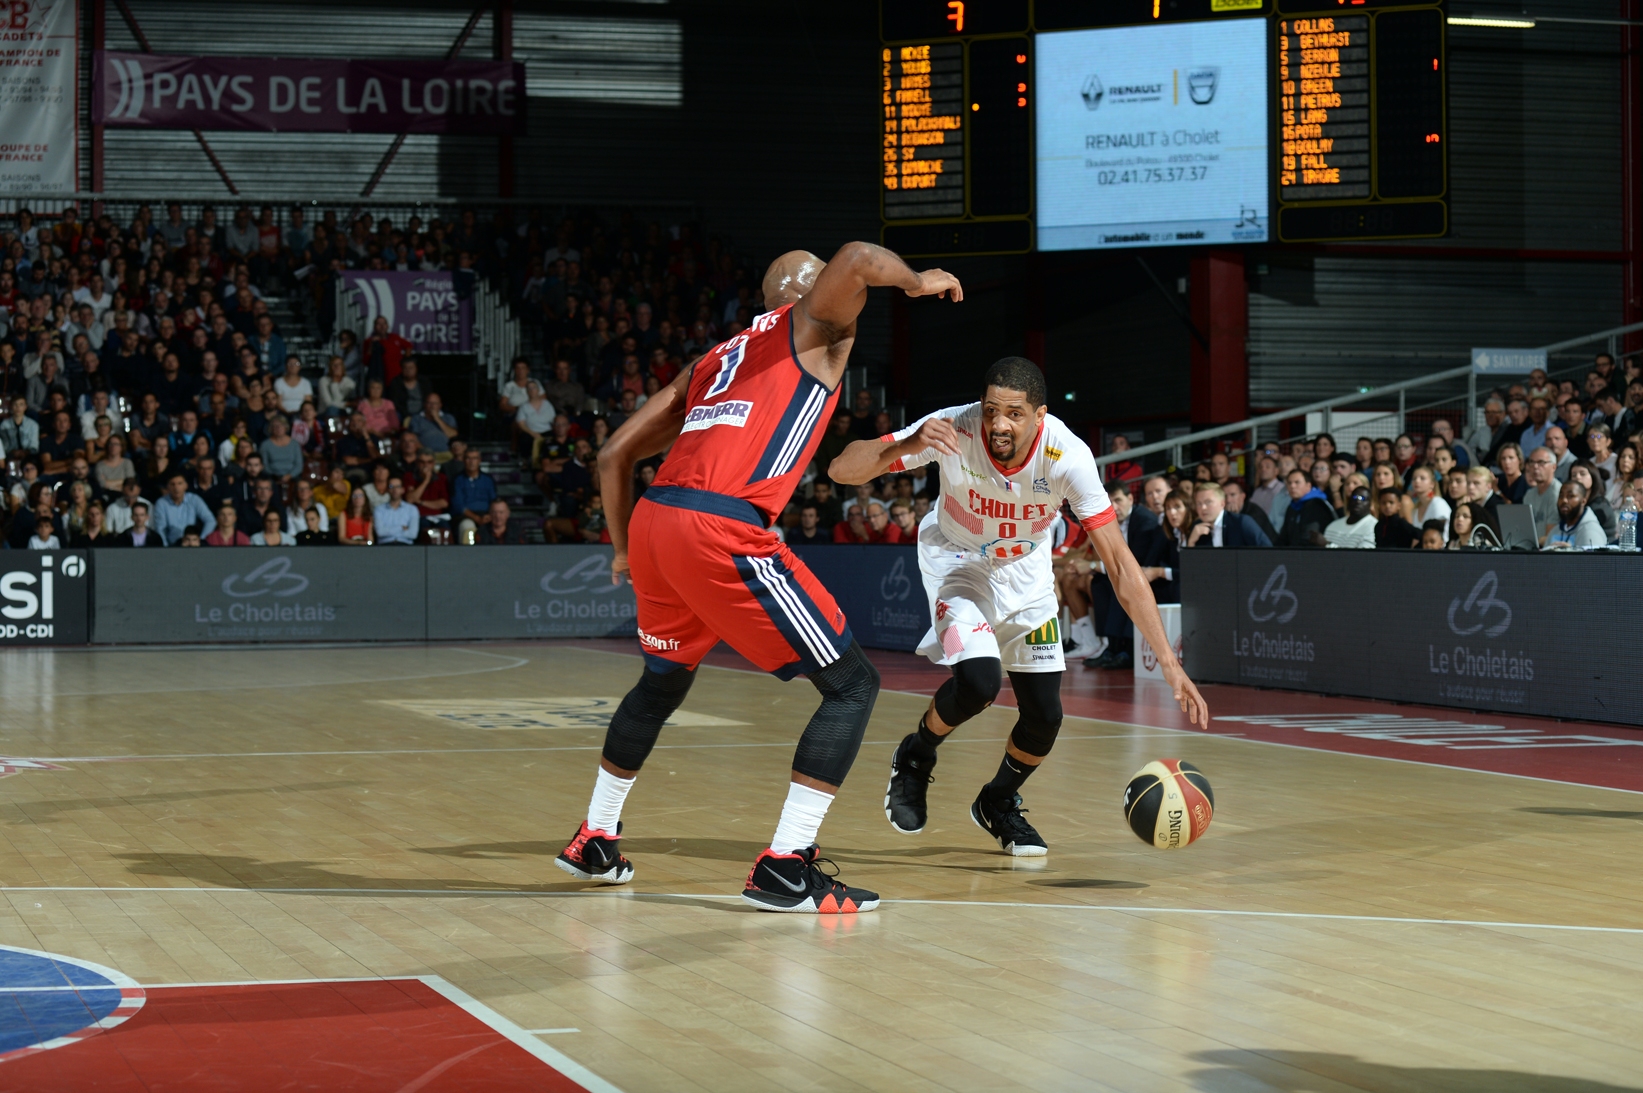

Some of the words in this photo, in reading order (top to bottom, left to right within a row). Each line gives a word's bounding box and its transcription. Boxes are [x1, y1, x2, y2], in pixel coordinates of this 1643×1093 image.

[1294, 18, 1335, 35] COLLINS
[47, 49, 60, 57] DE
[152, 73, 254, 113] PAYS
[269, 76, 321, 114] DE
[337, 77, 388, 114] LA
[401, 78, 517, 116] LOIRE
[1109, 84, 1163, 96] RENAULT
[1300, 78, 1334, 94] GREEN
[34, 144, 48, 152] DE
[1085, 131, 1157, 149] RENAULT
[1160, 131, 1170, 147] à
[1173, 128, 1220, 146] Cholet
[1301, 154, 1328, 169] FALL
[1098, 166, 1207, 185] 02.41.75.37.37
[406, 291, 459, 311] PAYS
[399, 323, 459, 342] LOIRE
[1492, 355, 1545, 368] SANITAIRES
[968, 488, 1048, 521] CHOLET
[195, 603, 222, 622] Le
[228, 602, 336, 622] Choletais
[514, 600, 541, 619] Le
[1233, 630, 1249, 657] Le
[1252, 631, 1315, 662] Choletais
[1429, 644, 1449, 674] Le
[1453, 646, 1534, 681] Choletais
